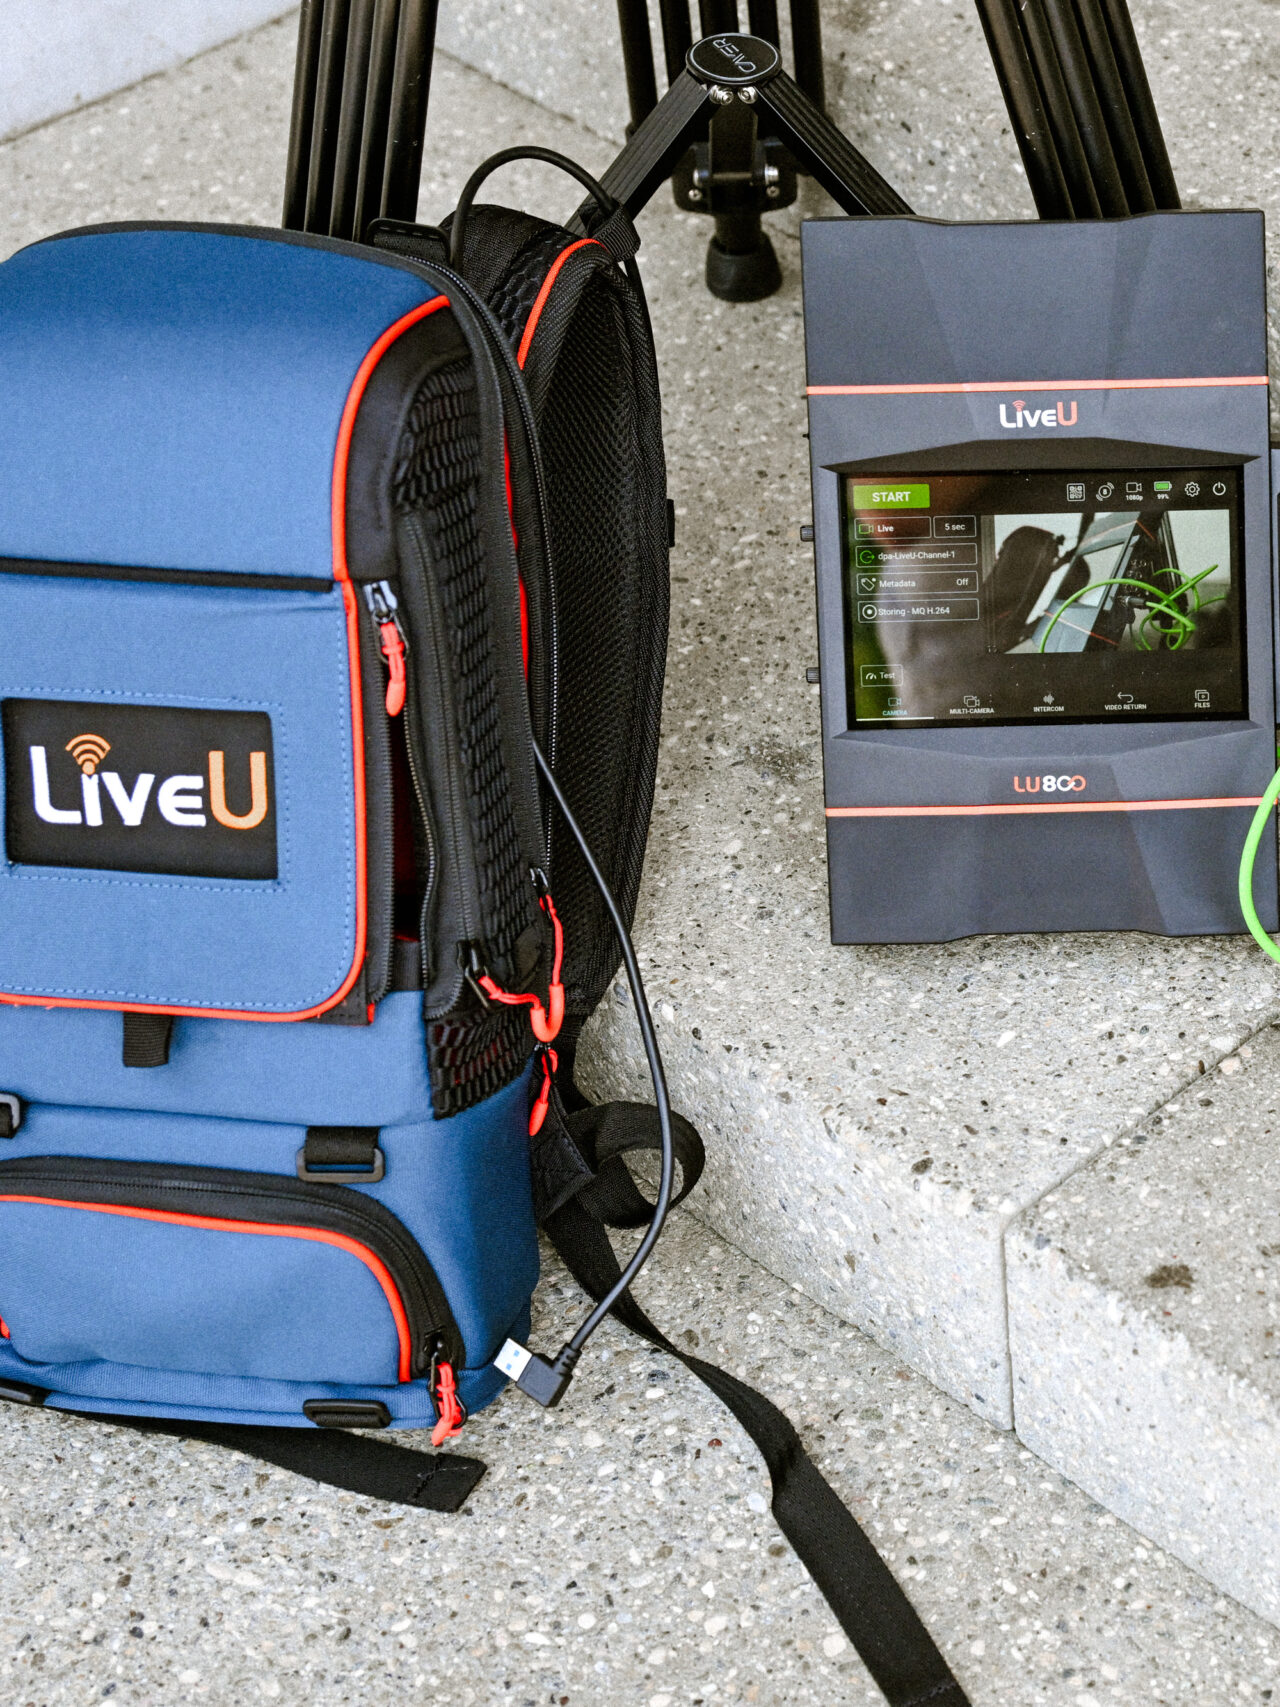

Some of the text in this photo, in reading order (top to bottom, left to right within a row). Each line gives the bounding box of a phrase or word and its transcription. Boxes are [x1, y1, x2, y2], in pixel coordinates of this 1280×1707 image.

[999, 400, 1078, 428] LiveU
[871, 491, 911, 502] START
[877, 524, 894, 532] Live
[944, 523, 950, 531] 5
[879, 580, 916, 588] Metadata
[956, 578, 969, 586] Off
[878, 608, 906, 617] Storing
[911, 607, 926, 615] MQ
[926, 606, 951, 614] H.264
[879, 671, 896, 679] Test
[949, 707, 994, 715] MULTI-CAMERA
[30, 734, 268, 829] LiveU
